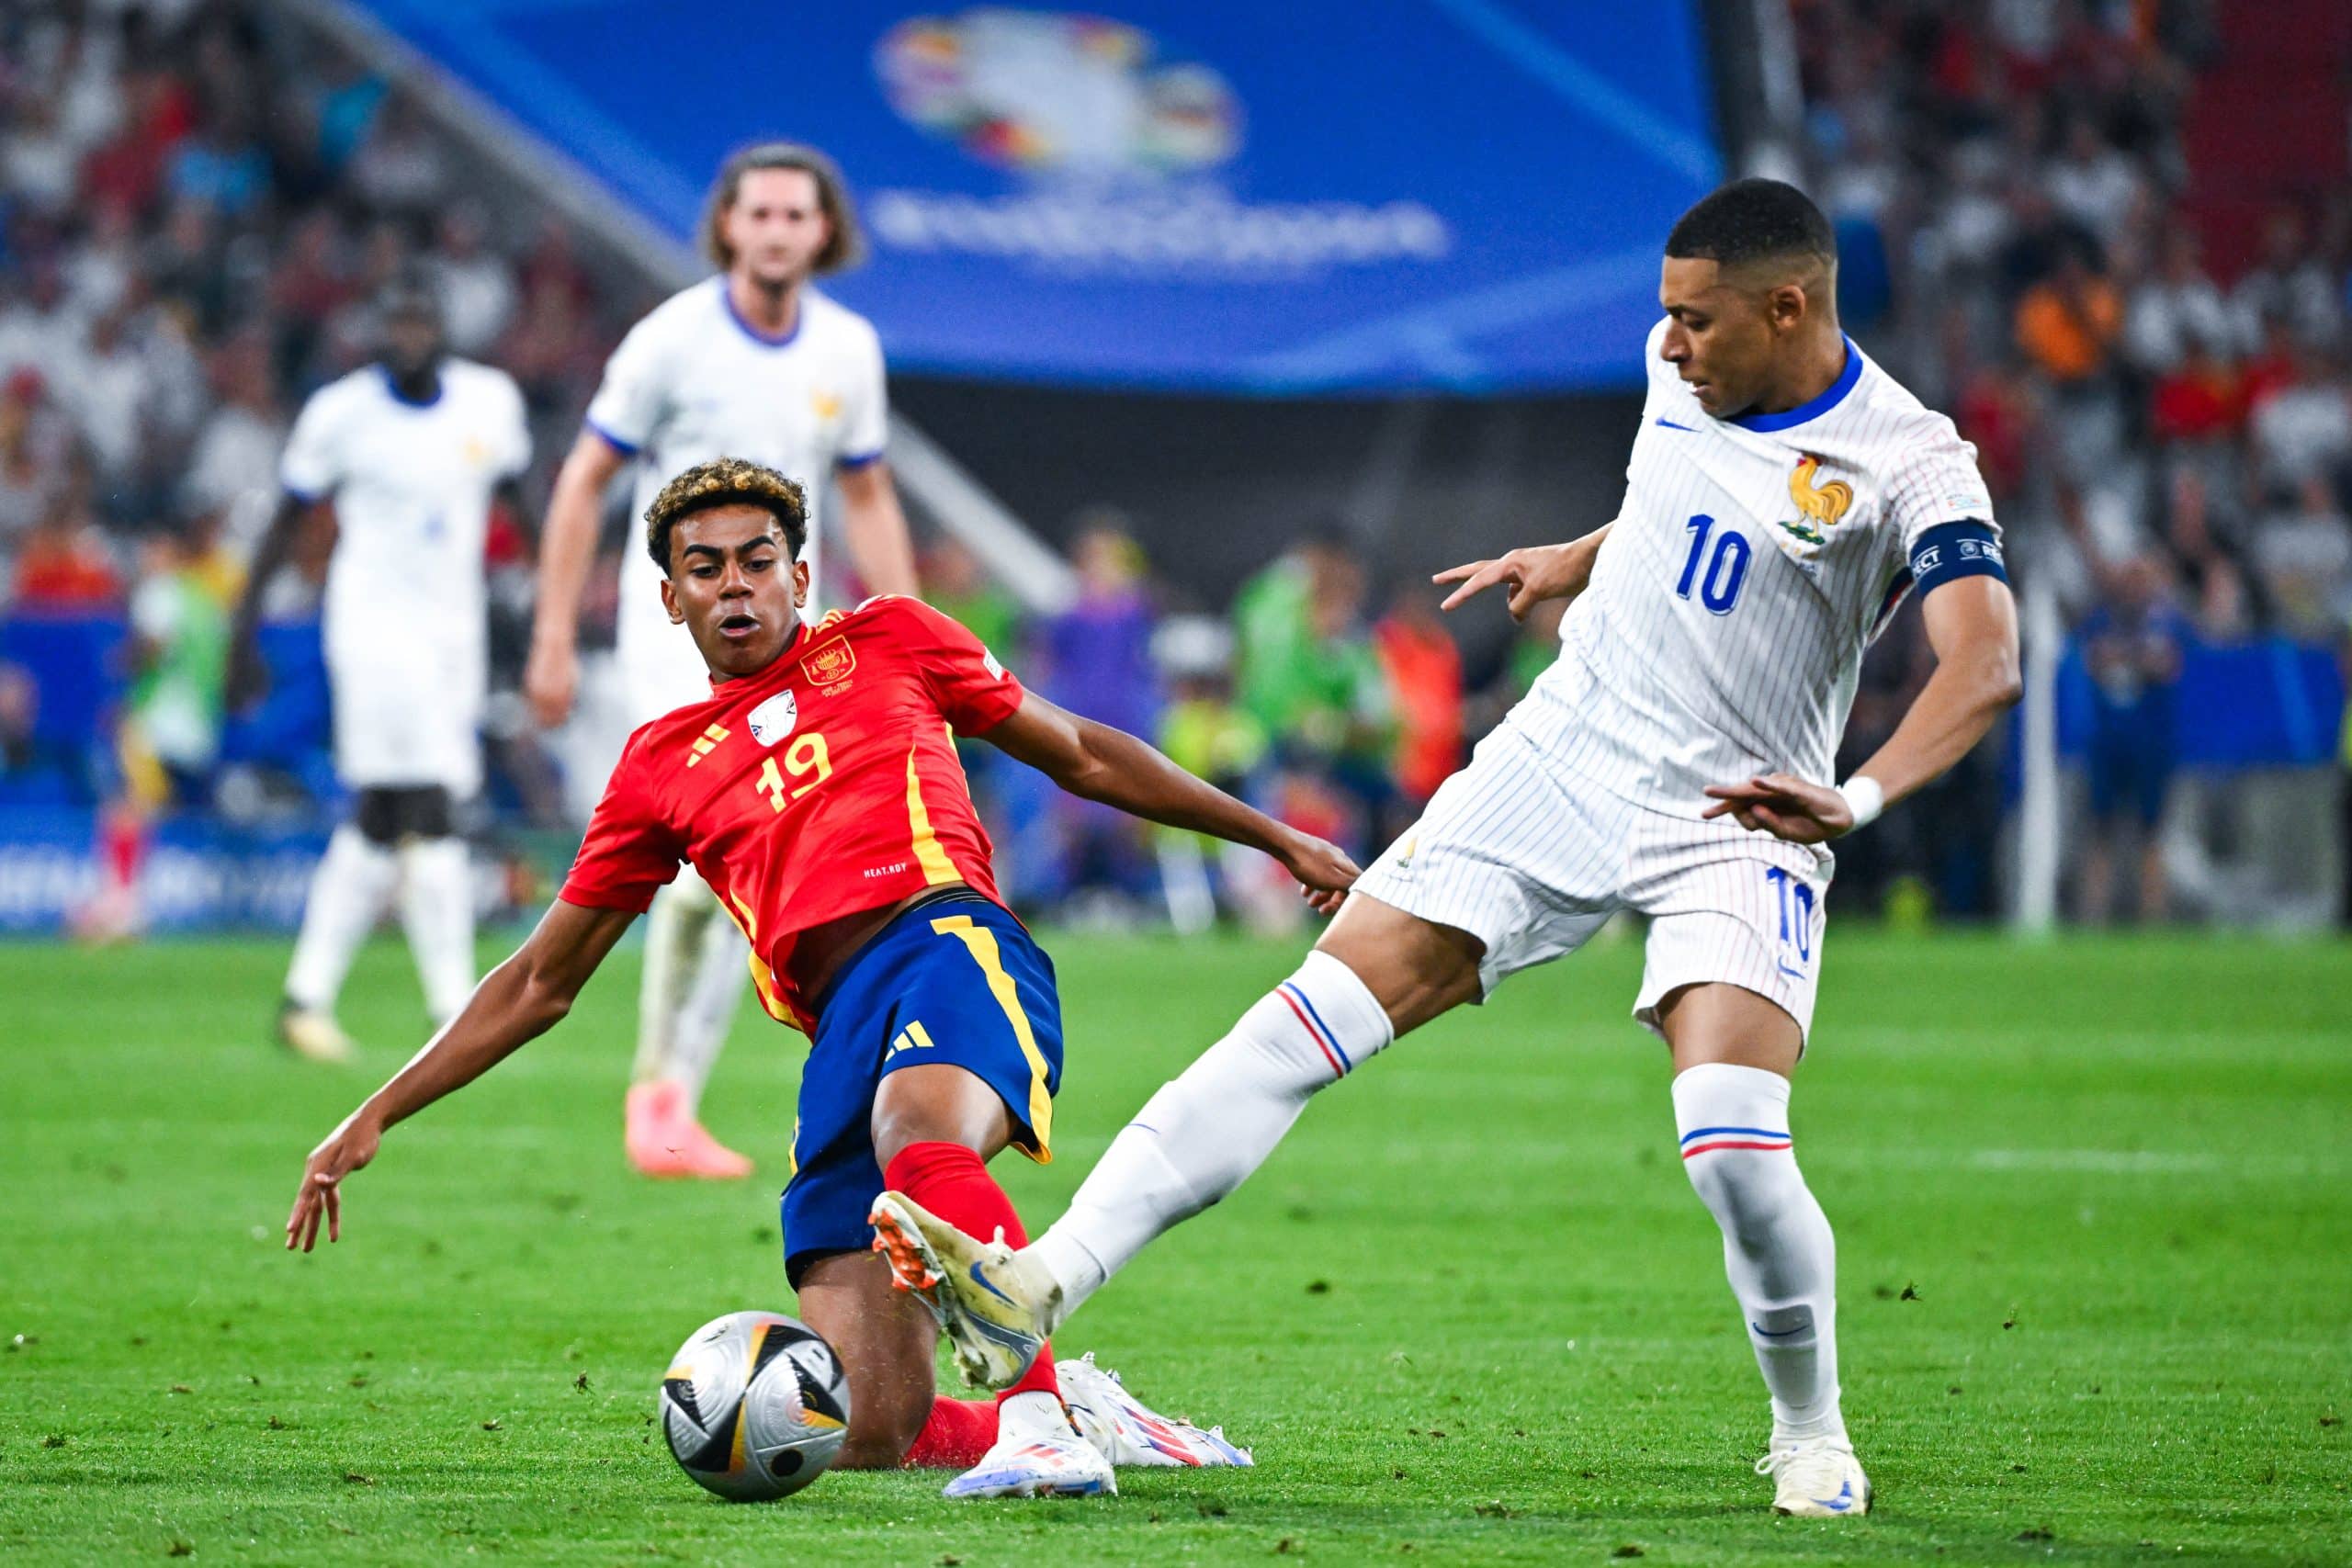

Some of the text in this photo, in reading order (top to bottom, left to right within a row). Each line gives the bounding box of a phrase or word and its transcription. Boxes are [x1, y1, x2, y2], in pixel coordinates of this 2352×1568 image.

[1676, 513, 1751, 616] 10
[755, 732, 832, 814] 19
[1766, 866, 1814, 963] 10
